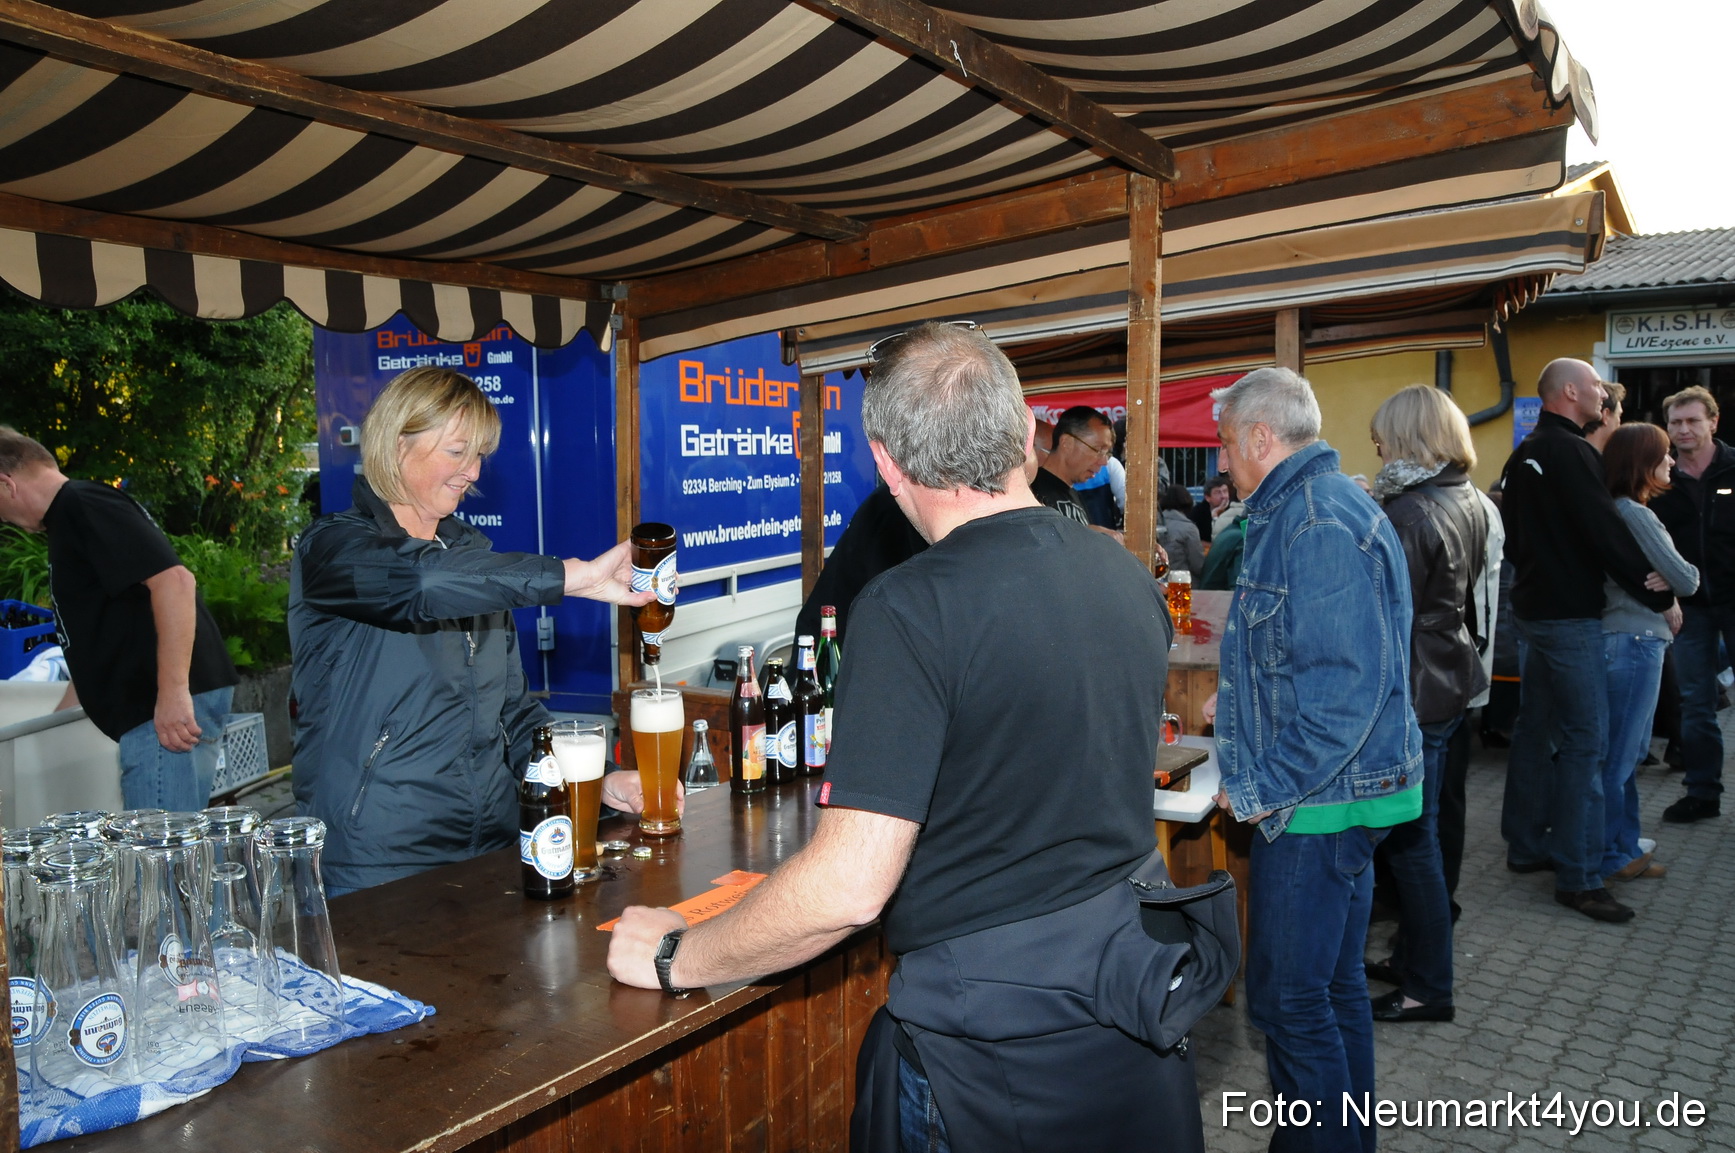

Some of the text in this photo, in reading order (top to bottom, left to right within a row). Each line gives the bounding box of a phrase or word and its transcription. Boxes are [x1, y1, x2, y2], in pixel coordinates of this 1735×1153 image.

[1703, 334, 1729, 345] e.V.
[378, 351, 513, 370] Getränke GmbH
[680, 424, 842, 457] Getränke mbH
[682, 479, 707, 495] 92334
[708, 477, 743, 495] Berching
[747, 475, 763, 490] Zum
[764, 473, 790, 492] Elysium
[790, 475, 795, 487] 2
[469, 514, 503, 527] von:
[83, 1016, 123, 1036] Gutmann
